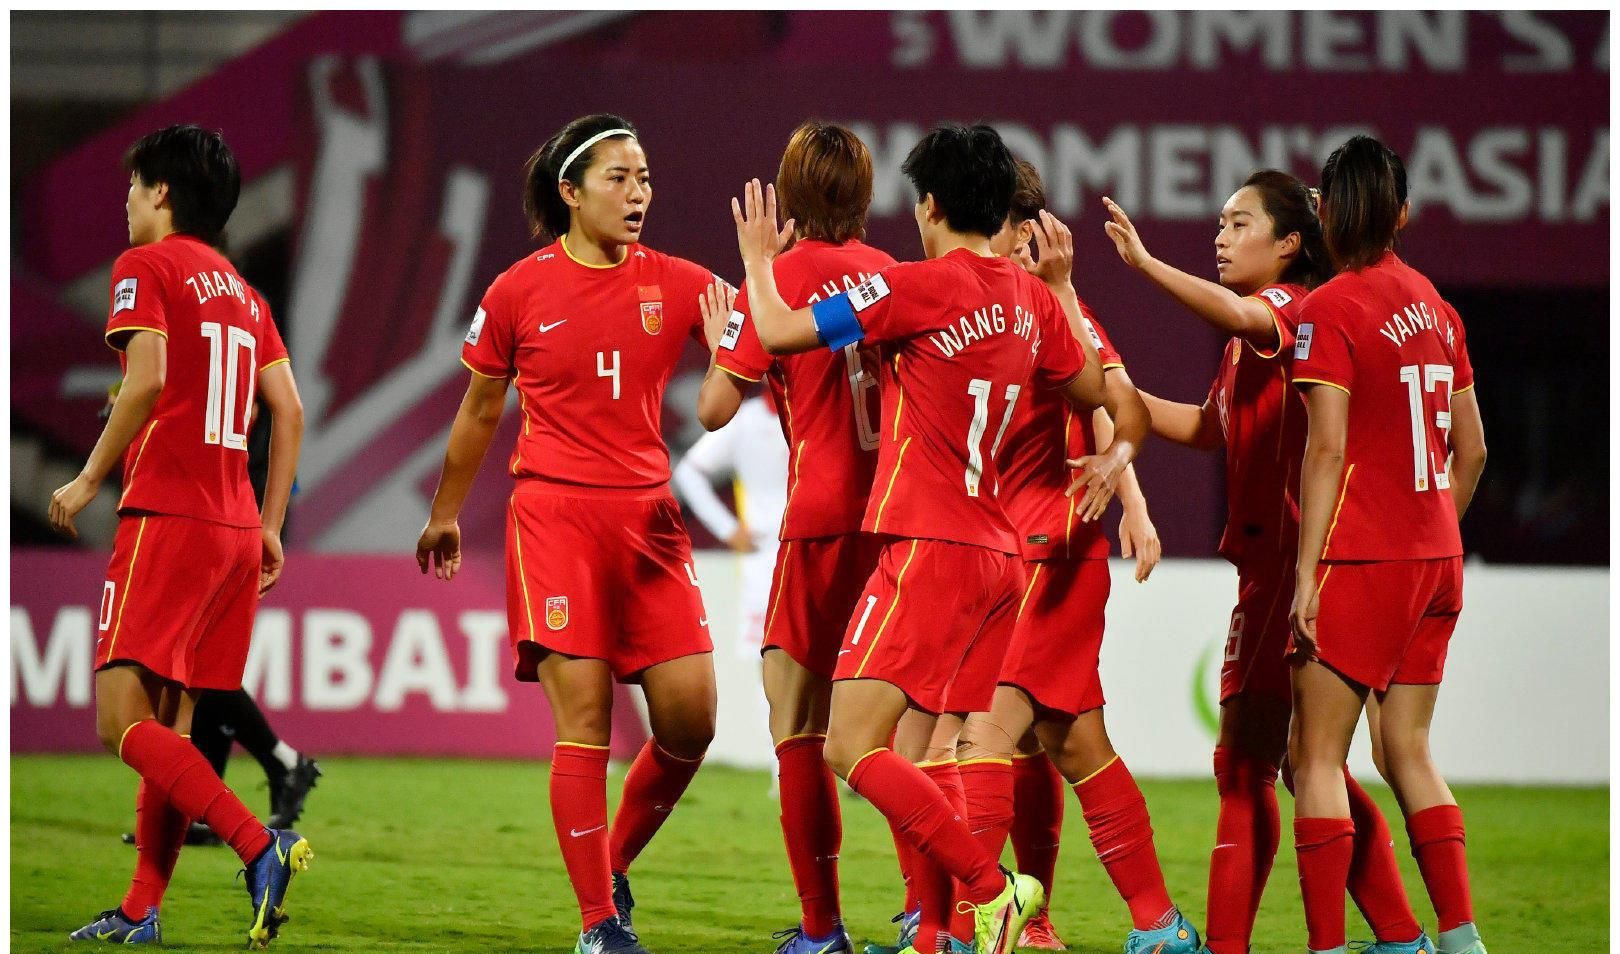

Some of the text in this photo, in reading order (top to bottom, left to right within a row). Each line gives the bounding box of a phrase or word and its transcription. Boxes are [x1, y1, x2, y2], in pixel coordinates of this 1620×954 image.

[947, 10, 1574, 72] WOMENS
[185, 270, 246, 305] ZHANG
[928, 303, 1006, 359] WANG
[1379, 301, 1432, 348] YANG
[200, 321, 257, 451] 10
[596, 350, 621, 400] 4
[1399, 364, 1454, 492] 13
[10, 605, 507, 712] MBAI
